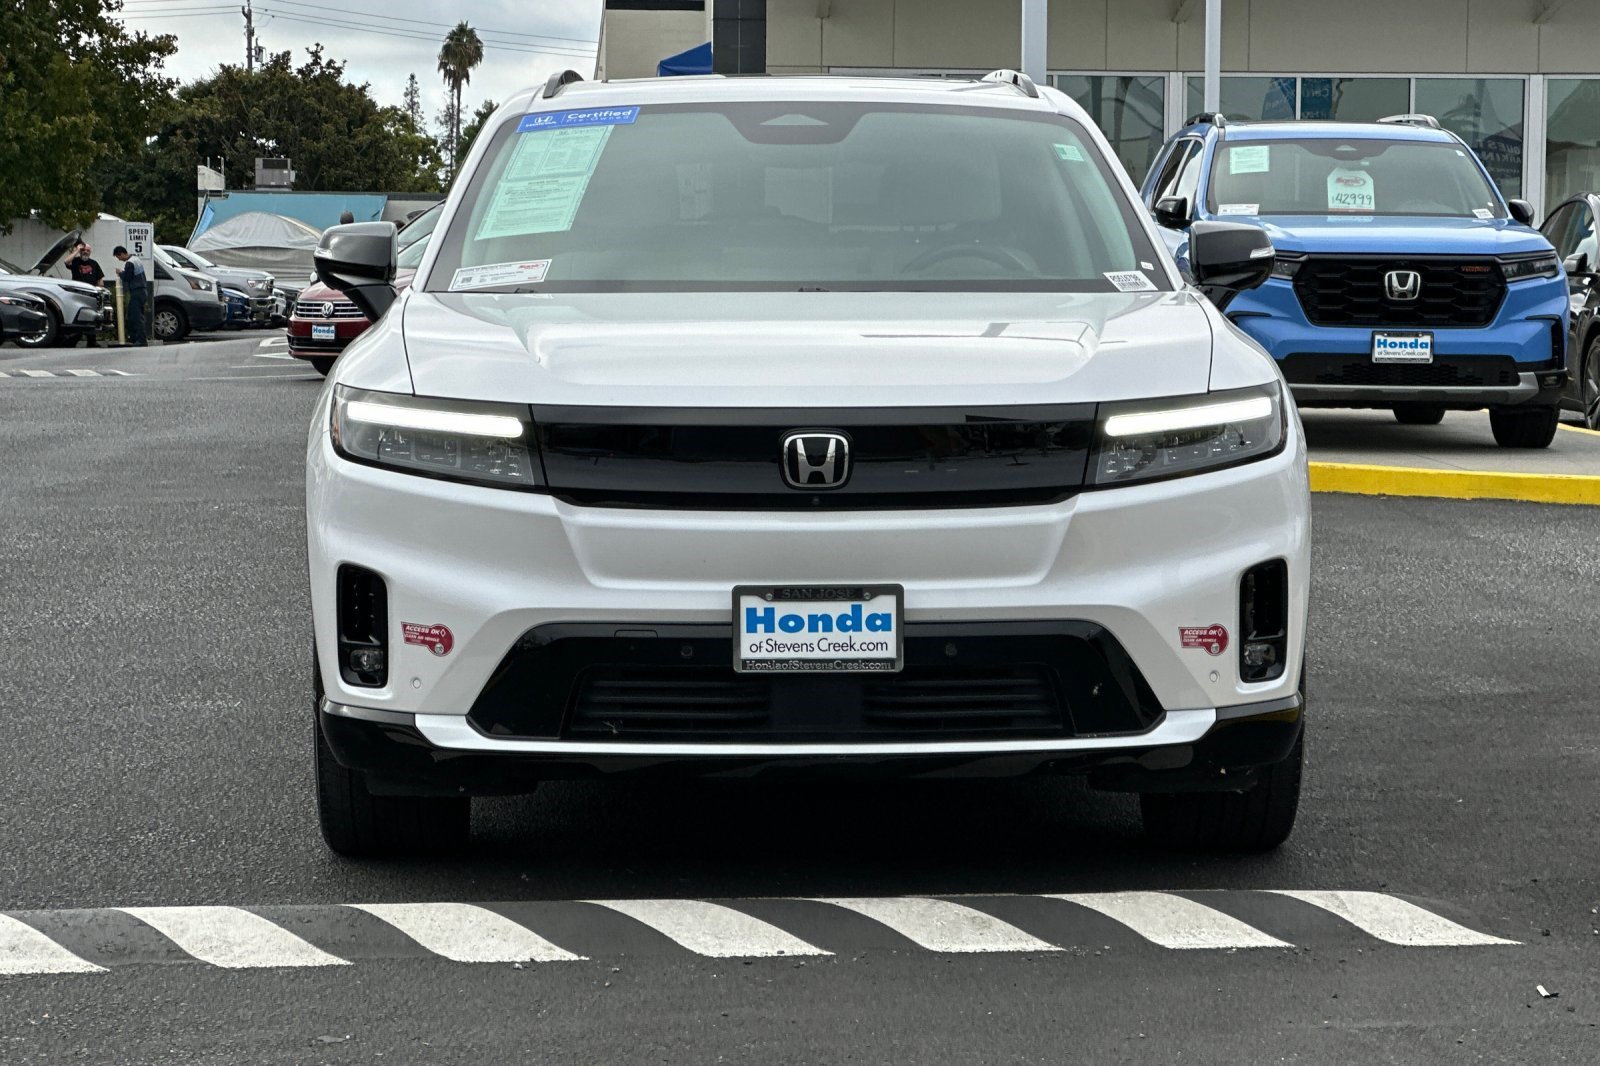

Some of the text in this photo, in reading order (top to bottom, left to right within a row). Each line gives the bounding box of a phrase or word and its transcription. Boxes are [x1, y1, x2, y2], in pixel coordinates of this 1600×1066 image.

[567, 109, 633, 120] Certified
[135, 242, 142, 253] 5
[1376, 338, 1429, 349] Honda
[781, 588, 858, 599] SAN JOSE
[745, 603, 893, 634] Honda
[406, 625, 429, 634] ACCESS
[749, 635, 889, 653] of Stevens Creek.com
